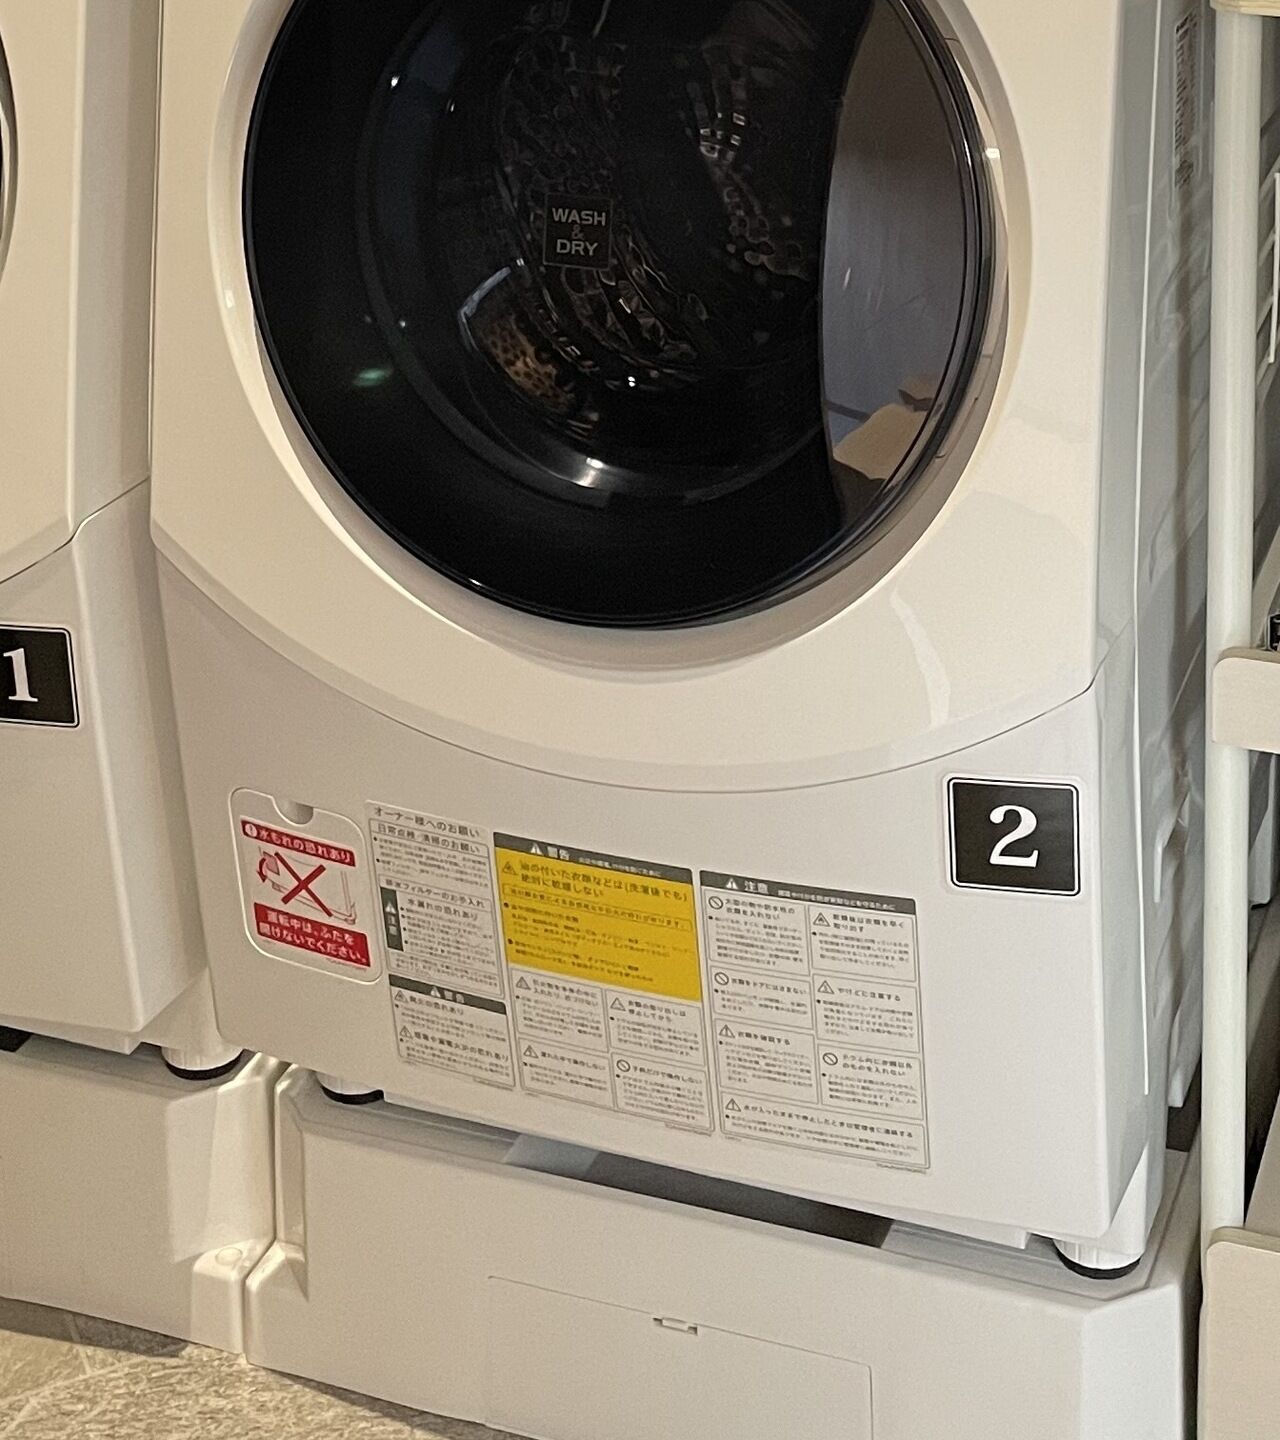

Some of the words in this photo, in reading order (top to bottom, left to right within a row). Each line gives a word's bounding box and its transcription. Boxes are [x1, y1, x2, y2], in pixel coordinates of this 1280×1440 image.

[551, 207, 607, 226] WASH
[571, 224, 584, 240] &
[556, 239, 598, 256] DRY
[3, 647, 38, 702] 1
[374, 806, 480, 838] オーナー様へのお願い
[989, 805, 1039, 868] 2
[259, 829, 351, 863] 水もれの恐れあり
[744, 880, 769, 894] 注意
[408, 898, 478, 921] 水漏れの恐れあり
[259, 922, 367, 963] 開けないでください。
[267, 911, 355, 945] 運転中は、ふたを
